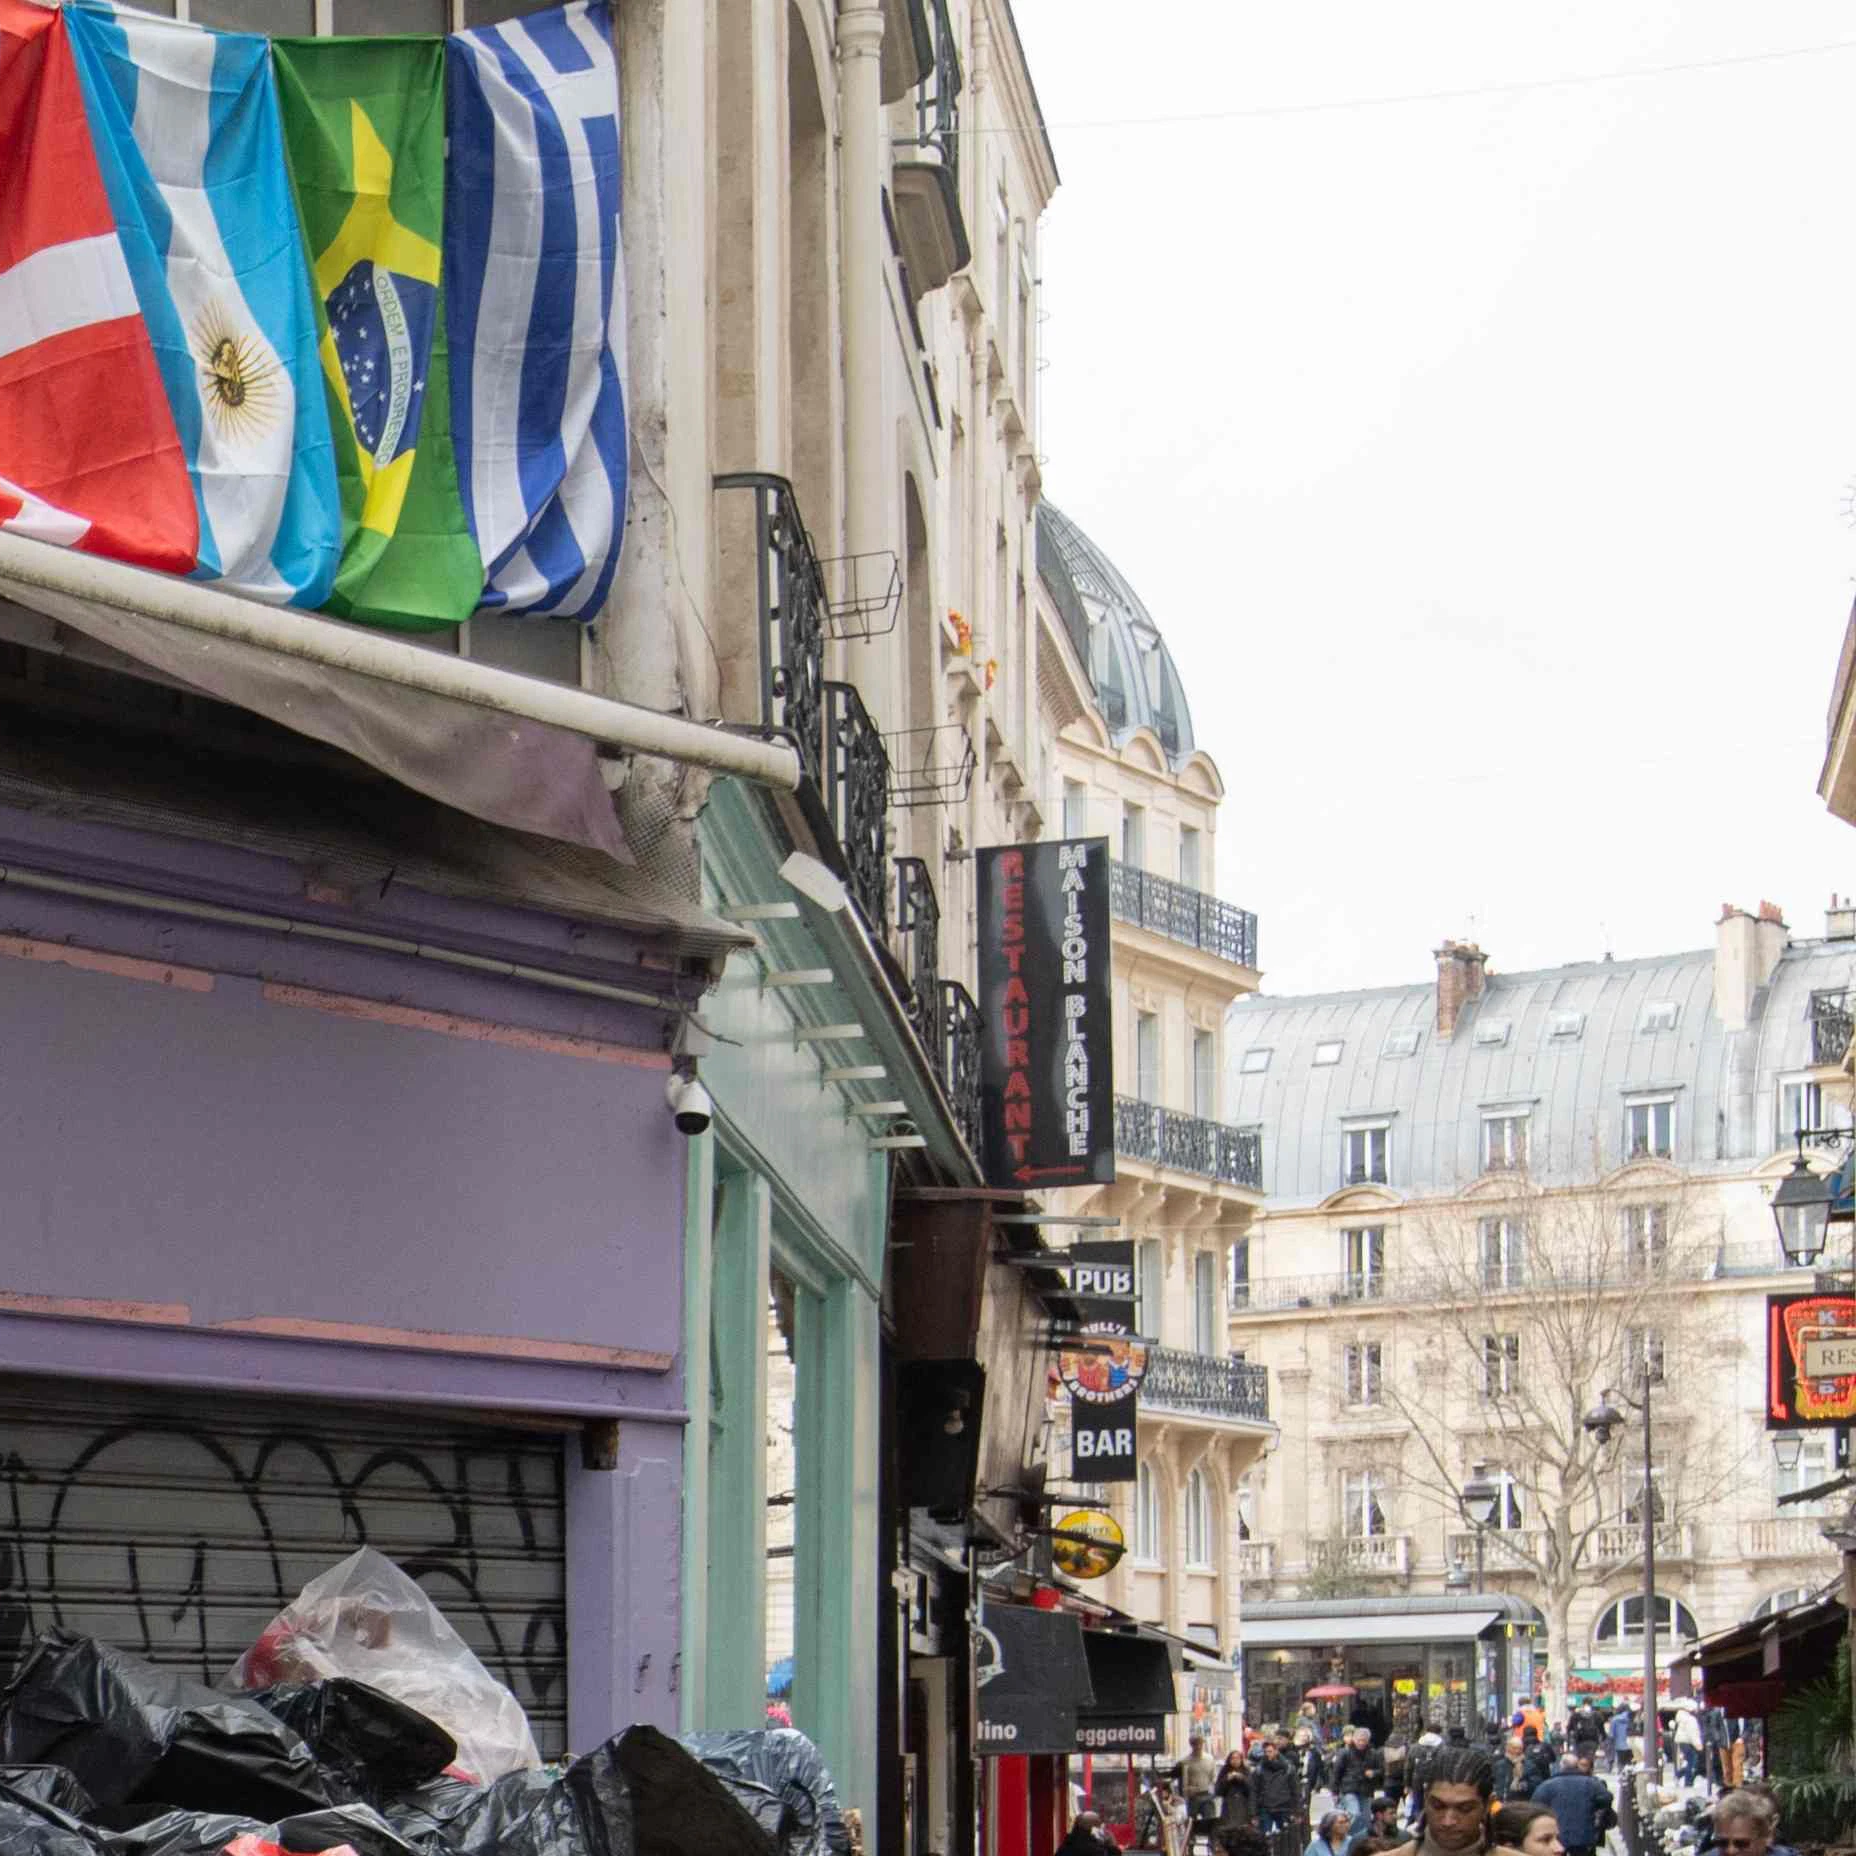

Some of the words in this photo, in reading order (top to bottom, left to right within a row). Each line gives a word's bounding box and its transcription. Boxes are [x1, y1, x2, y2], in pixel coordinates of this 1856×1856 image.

[1058, 843, 1087, 985] MAISON
[999, 849, 1032, 1162] RESTAURANT
[1063, 994, 1090, 1157] BLANCHE
[1076, 1268, 1131, 1295] PUB
[1070, 1377, 1138, 1403] BROTHERS
[1076, 1429, 1132, 1458] BAR
[1075, 1722, 1157, 1744] eggaeton
